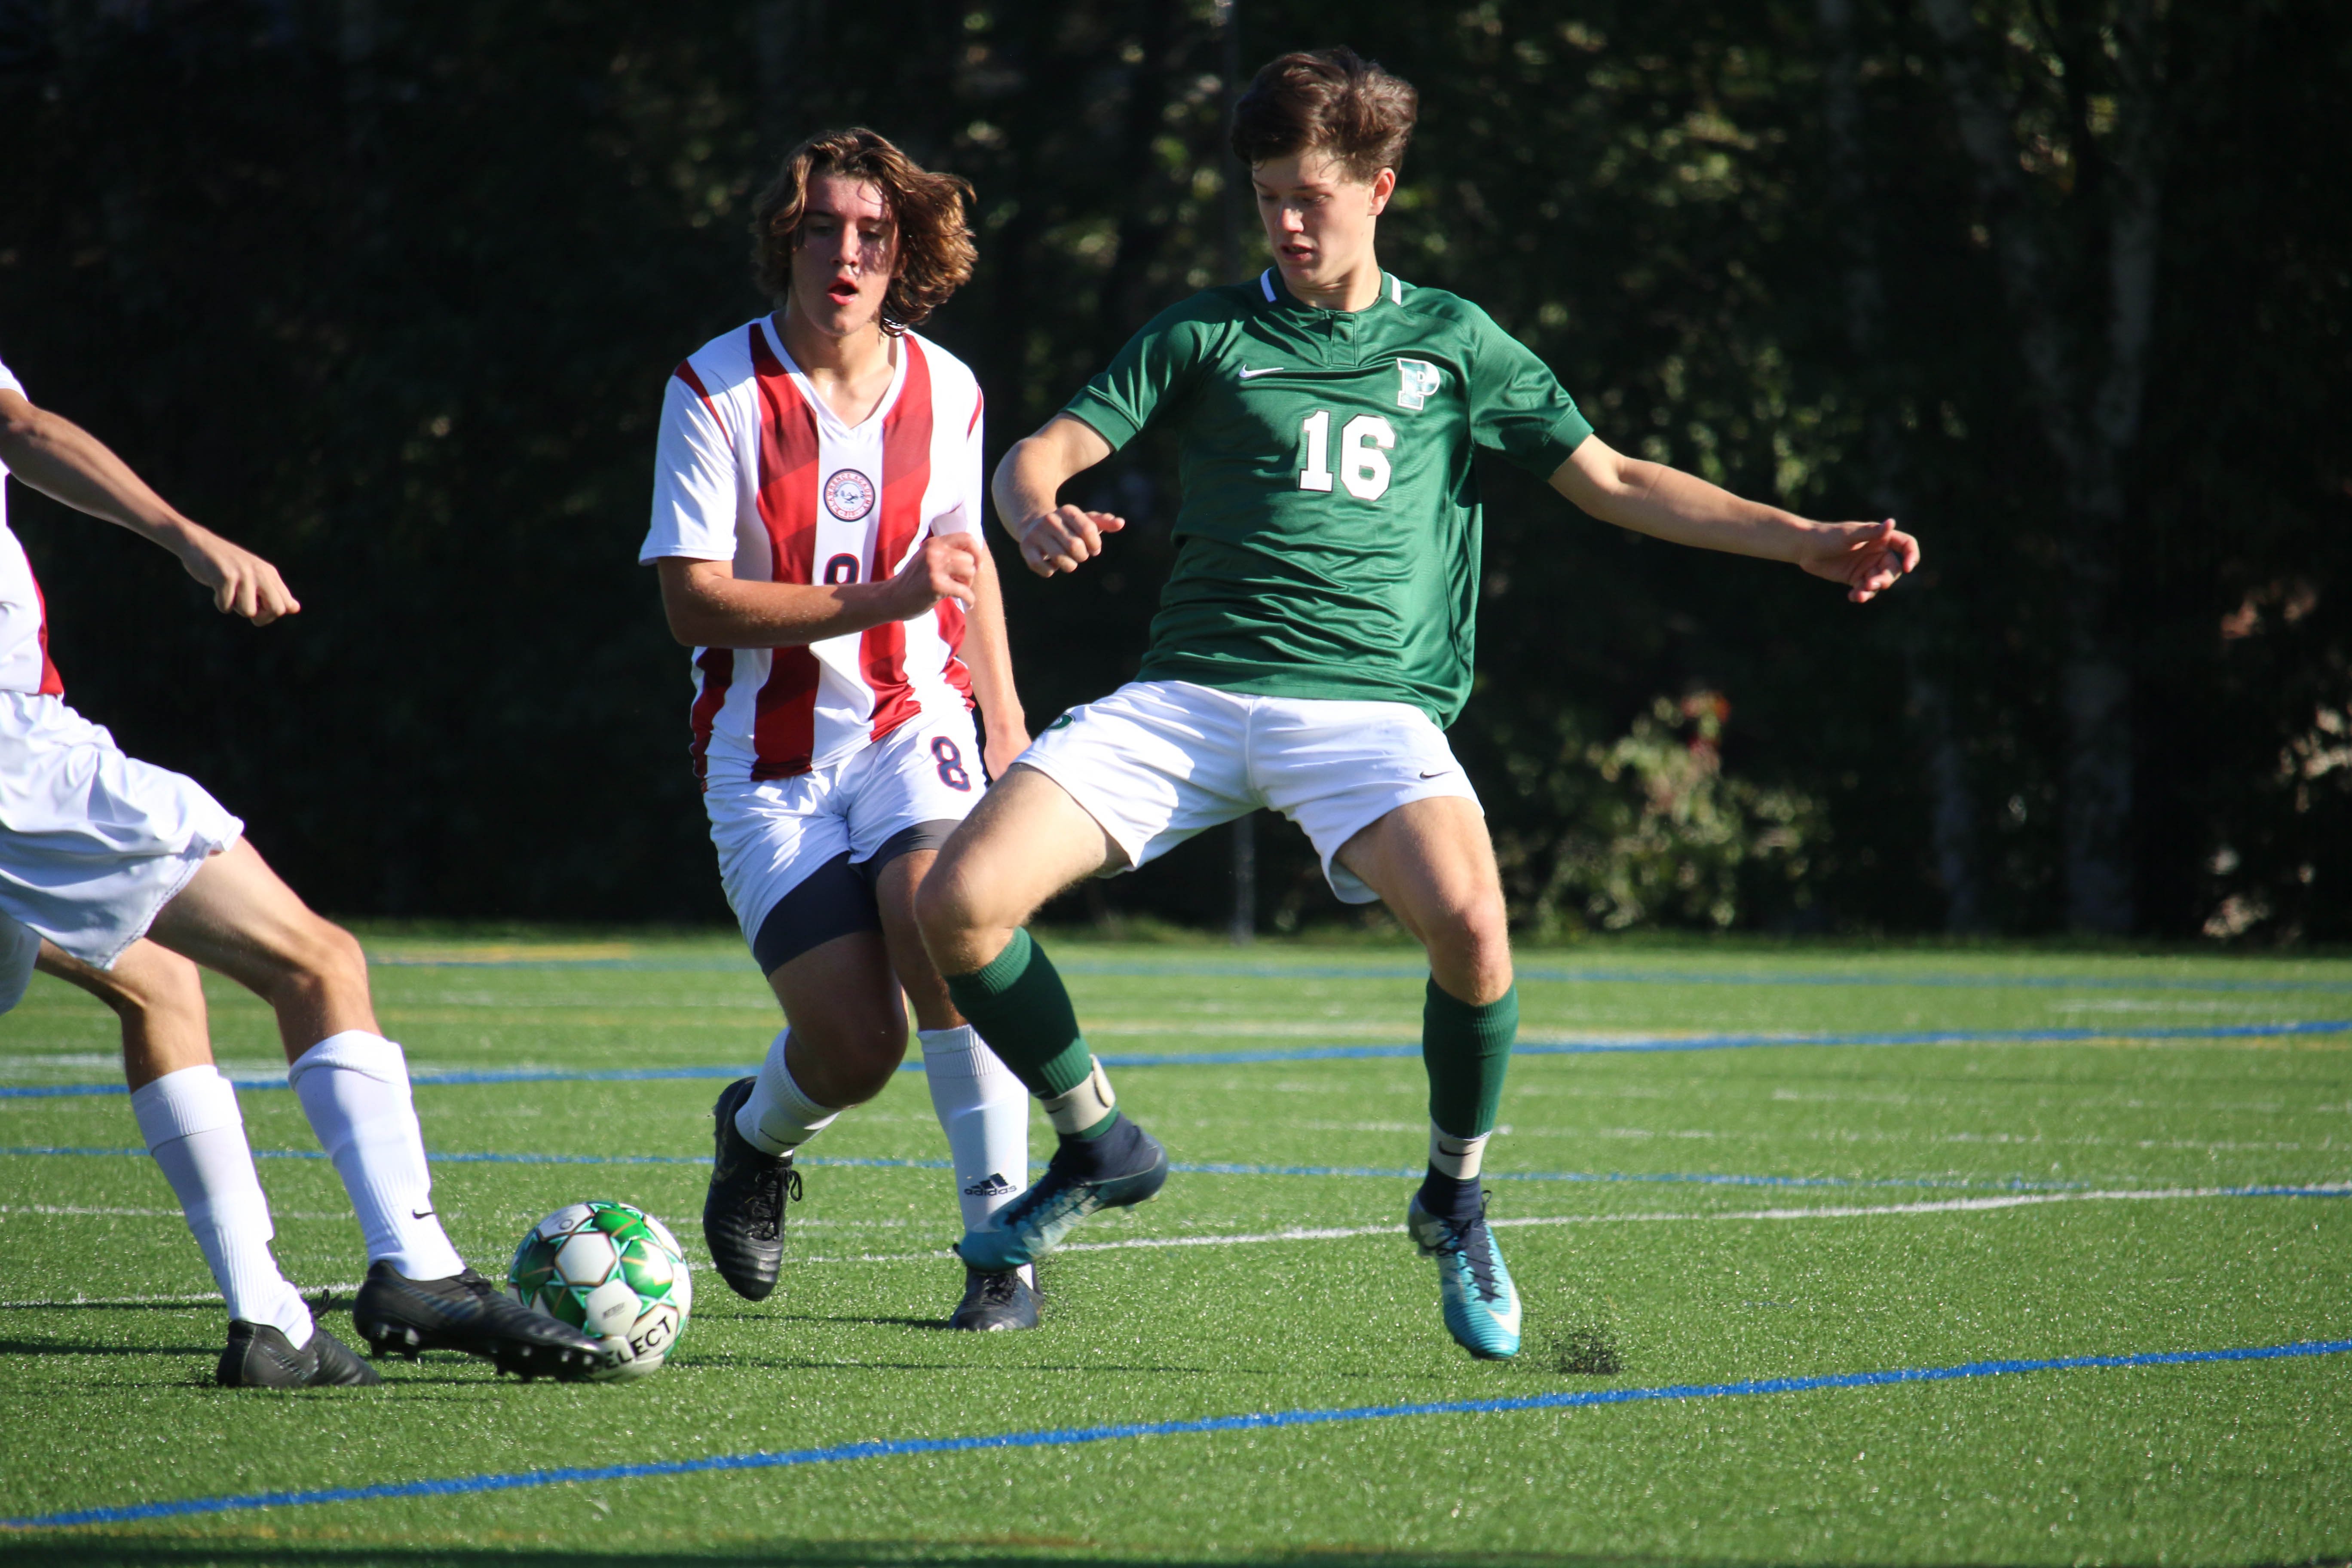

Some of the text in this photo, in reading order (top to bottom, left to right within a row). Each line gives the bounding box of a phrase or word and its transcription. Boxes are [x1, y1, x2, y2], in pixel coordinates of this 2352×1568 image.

[1396, 358, 1441, 410] P
[1299, 410, 1396, 501] 16
[930, 736, 971, 792] 8
[964, 1185, 1017, 1196] adidas
[601, 1315, 670, 1370] ELECT
